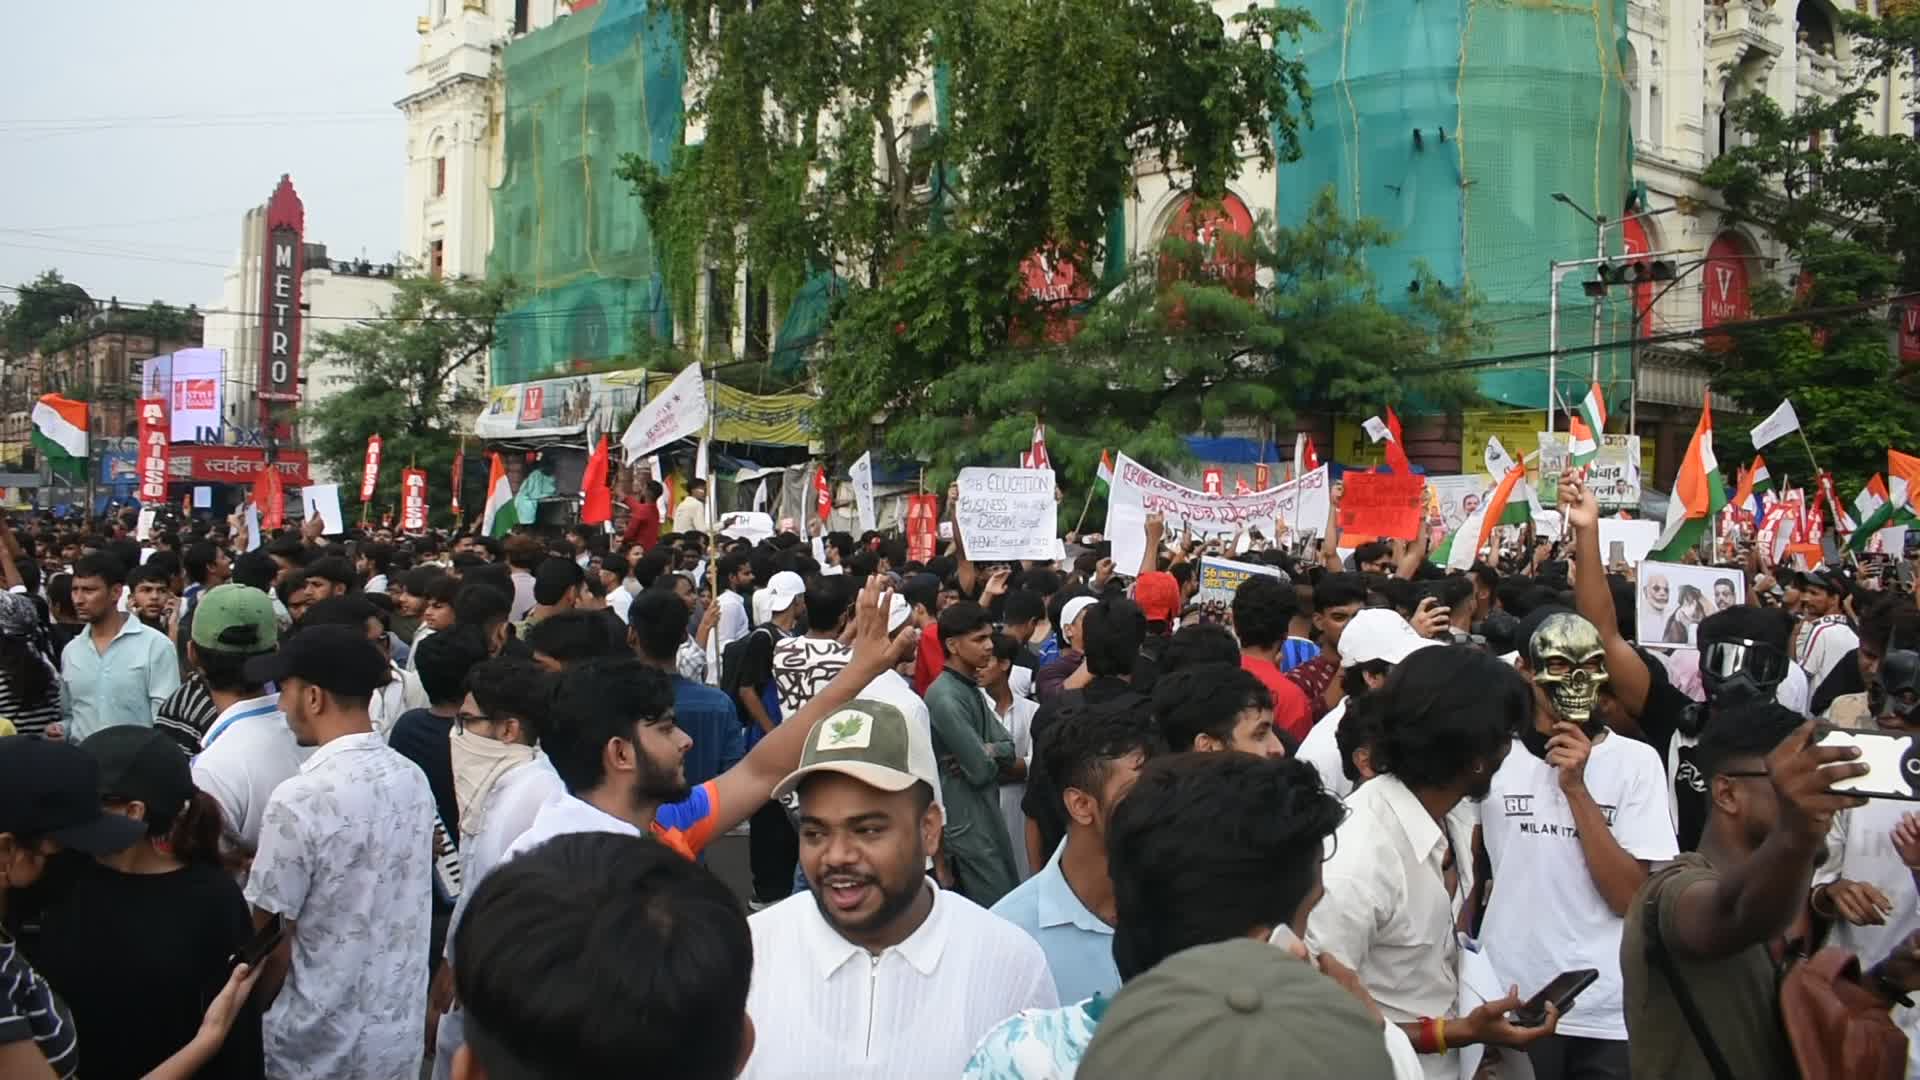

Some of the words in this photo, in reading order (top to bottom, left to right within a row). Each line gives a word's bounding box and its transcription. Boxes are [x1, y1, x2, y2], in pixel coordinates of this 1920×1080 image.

[1715, 267, 1734, 300] V
[271, 244, 291, 383] METRO
[1711, 303, 1736, 318] MART
[143, 431, 167, 498] AIDSO
[365, 442, 379, 496] AIDSO
[405, 474, 424, 528] AIDSO
[1203, 566, 1217, 578] 56
[1520, 822, 1558, 836] MILAN
